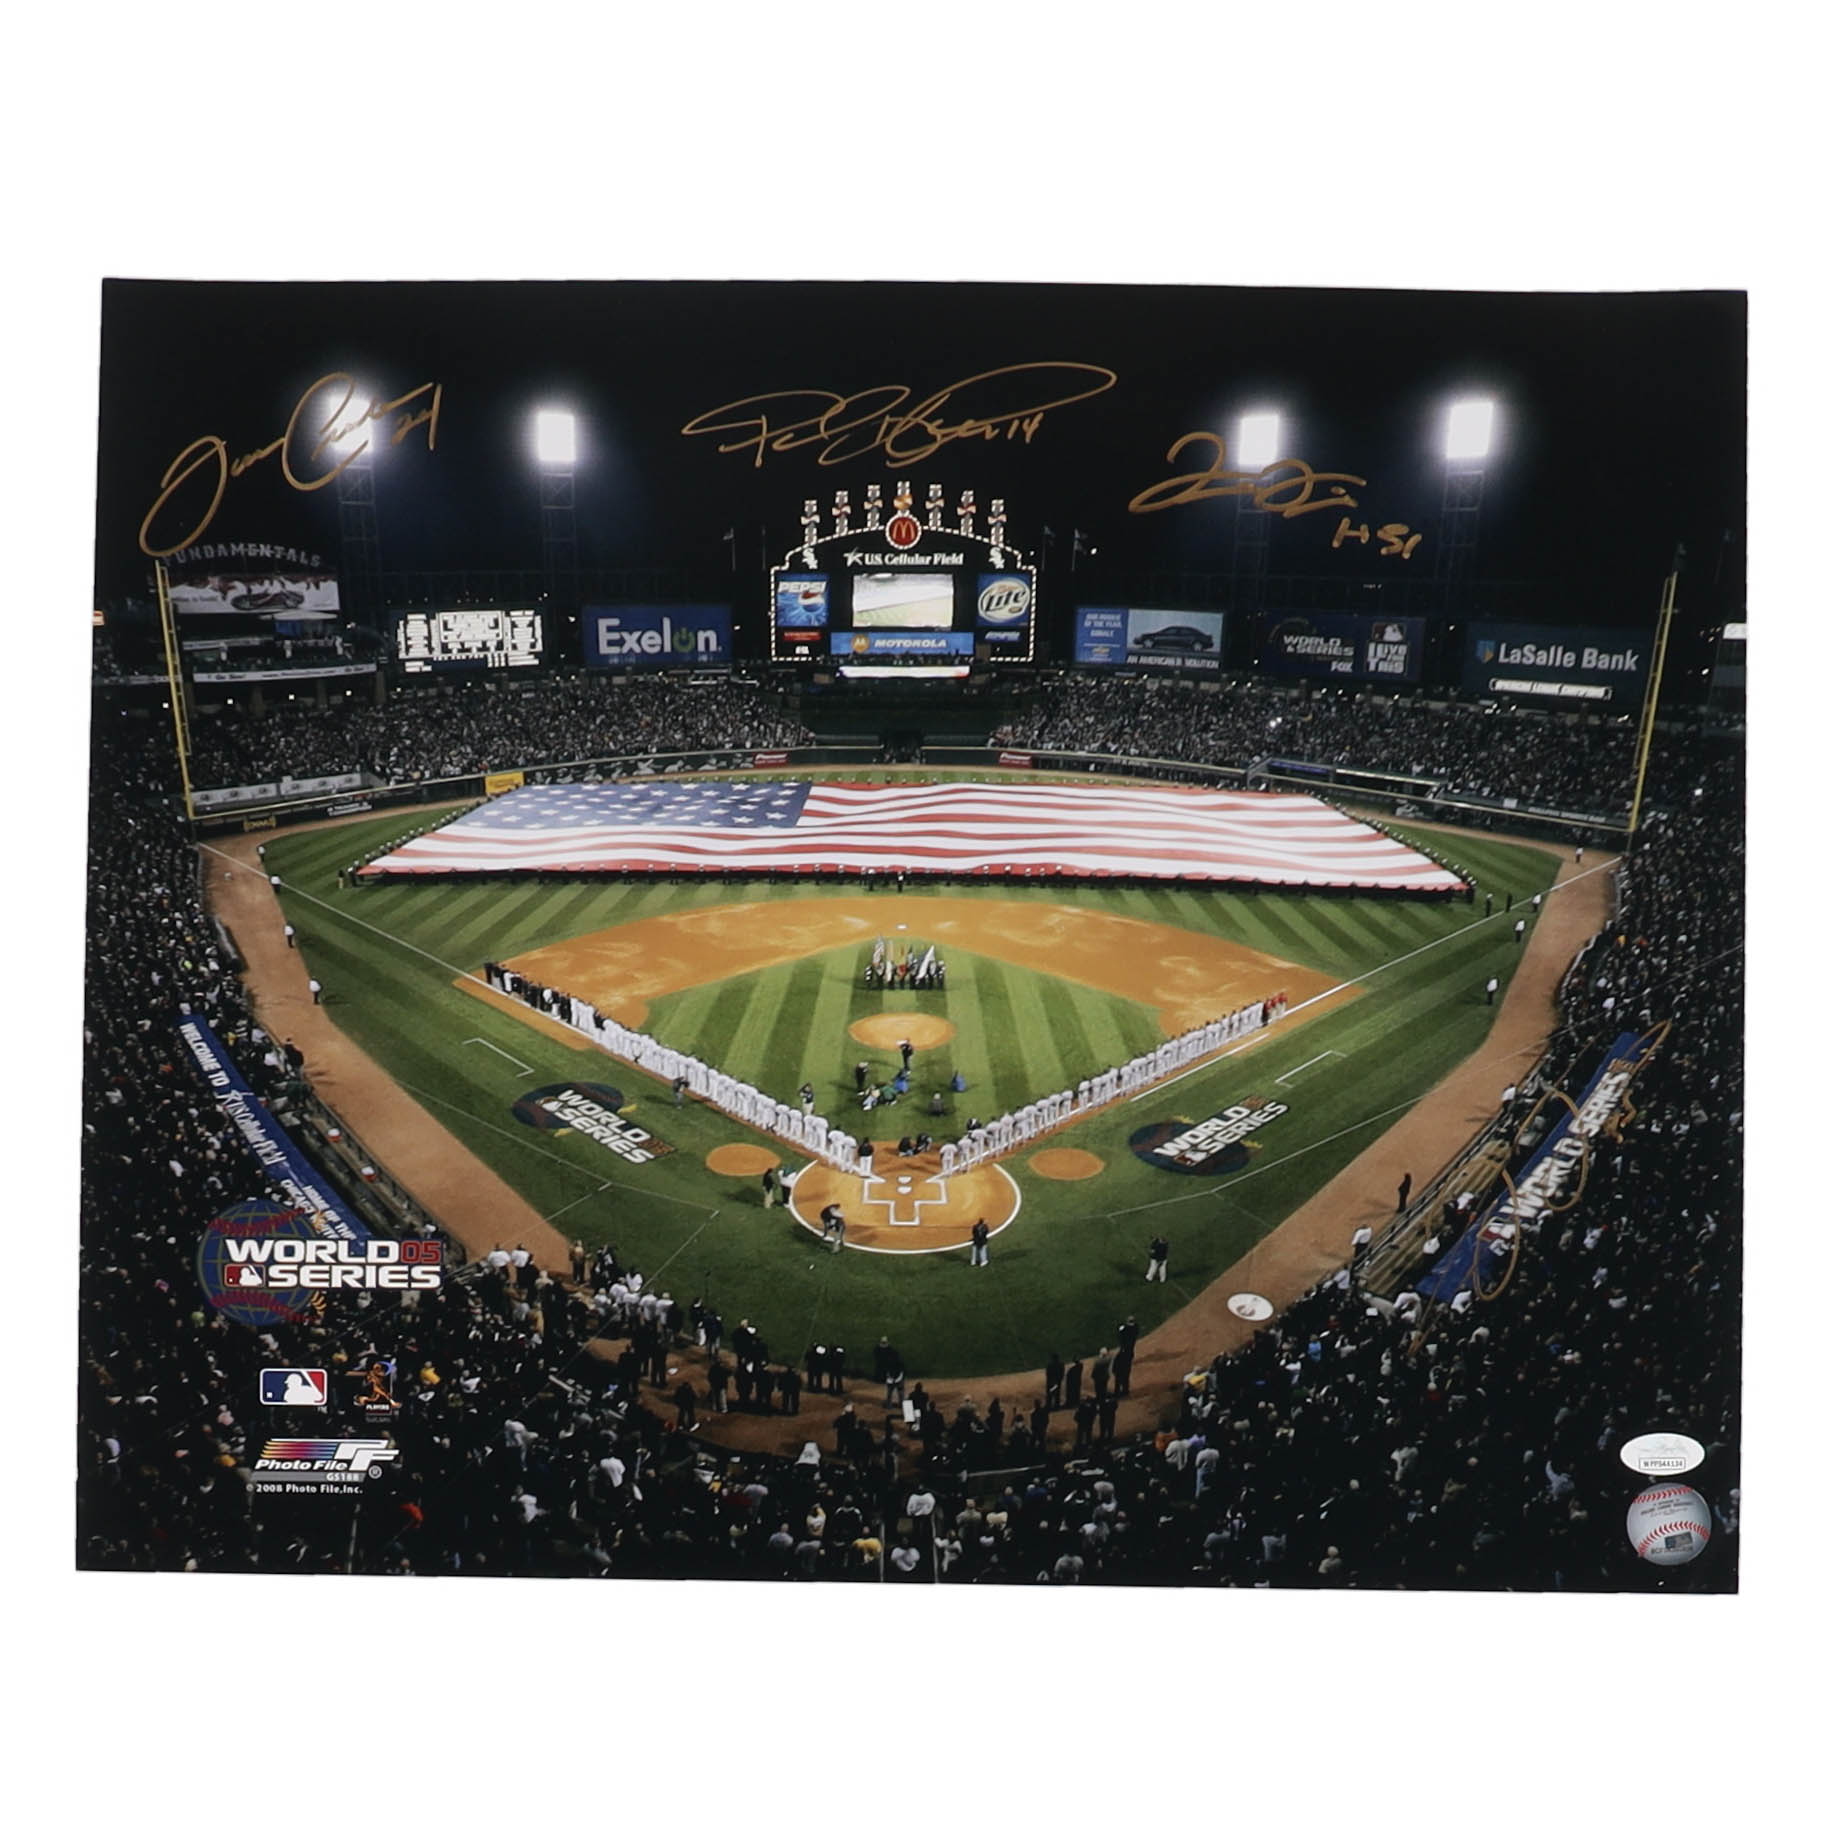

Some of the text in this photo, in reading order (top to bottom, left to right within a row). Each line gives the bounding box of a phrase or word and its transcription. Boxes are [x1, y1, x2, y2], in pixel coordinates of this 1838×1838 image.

[885, 552, 931, 565] Cellular
[934, 552, 964, 565] Field
[777, 581, 826, 593] PEPSI
[875, 639, 947, 648] MOTOROLA
[1283, 634, 1341, 647] WORLD
[1499, 643, 1640, 671] LaSalle Bank
[179, 1021, 222, 1072] WELCOME
[207, 1068, 231, 1088] TO
[554, 1107, 655, 1164] SERIES
[558, 1089, 651, 1143] WORLD
[1152, 1105, 1250, 1157] WORLD
[1197, 1101, 1289, 1154] SERIES
[1500, 1136, 1585, 1218] WORLD
